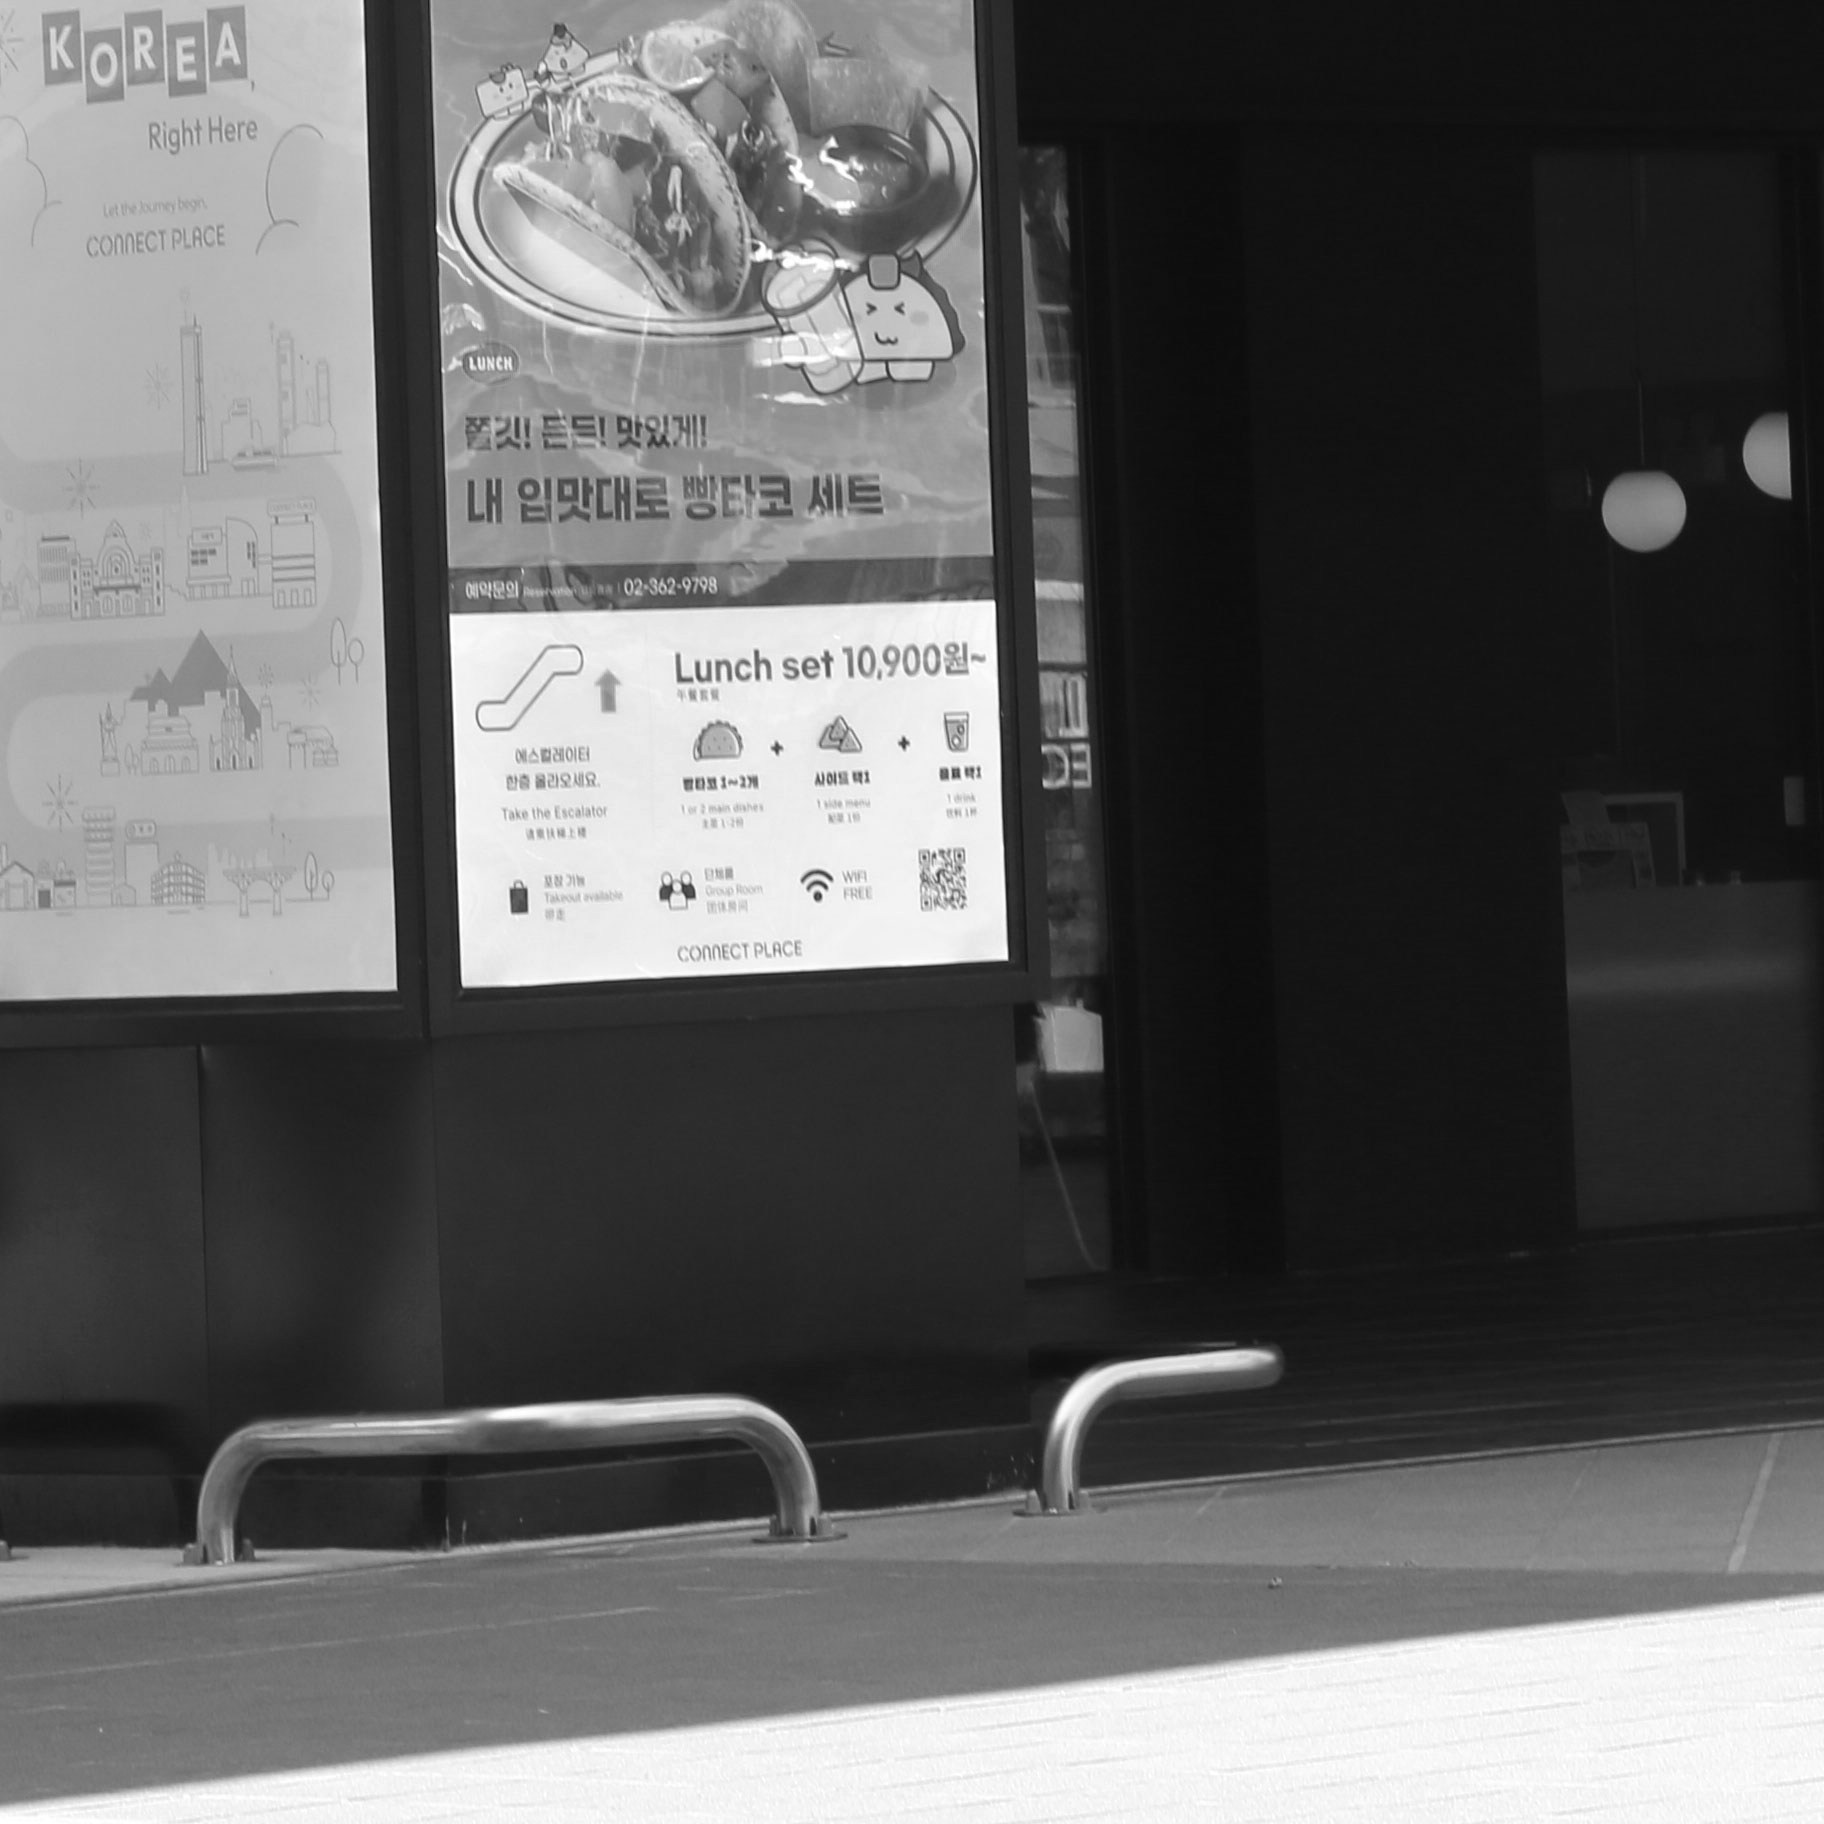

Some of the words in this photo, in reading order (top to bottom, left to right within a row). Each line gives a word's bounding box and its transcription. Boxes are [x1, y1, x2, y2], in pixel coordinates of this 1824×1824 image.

[147, 119, 203, 156] Right
[208, 115, 258, 142] Here
[86, 229, 167, 259] CONNECT
[172, 224, 227, 251] PLACE
[467, 354, 515, 372] LUNCH
[541, 414, 606, 450] 든든!
[616, 413, 708, 451] 맛있게!
[466, 477, 500, 523] 내
[517, 476, 670, 523] 입맛대로
[683, 475, 794, 521] 빵타코
[808, 472, 886, 517] 세트
[623, 577, 719, 597] 02-362-9798
[674, 649, 773, 684] Lunch
[782, 650, 835, 681] set
[514, 746, 591, 764] 에스컬레이터
[501, 806, 529, 822] Take
[531, 806, 551, 821] the
[554, 804, 608, 821] Escalator
[705, 884, 734, 898] Group
[736, 883, 763, 895] Room
[843, 885, 873, 901] FREE
[677, 942, 750, 963] CONNECT
[753, 939, 803, 960] PLACE
